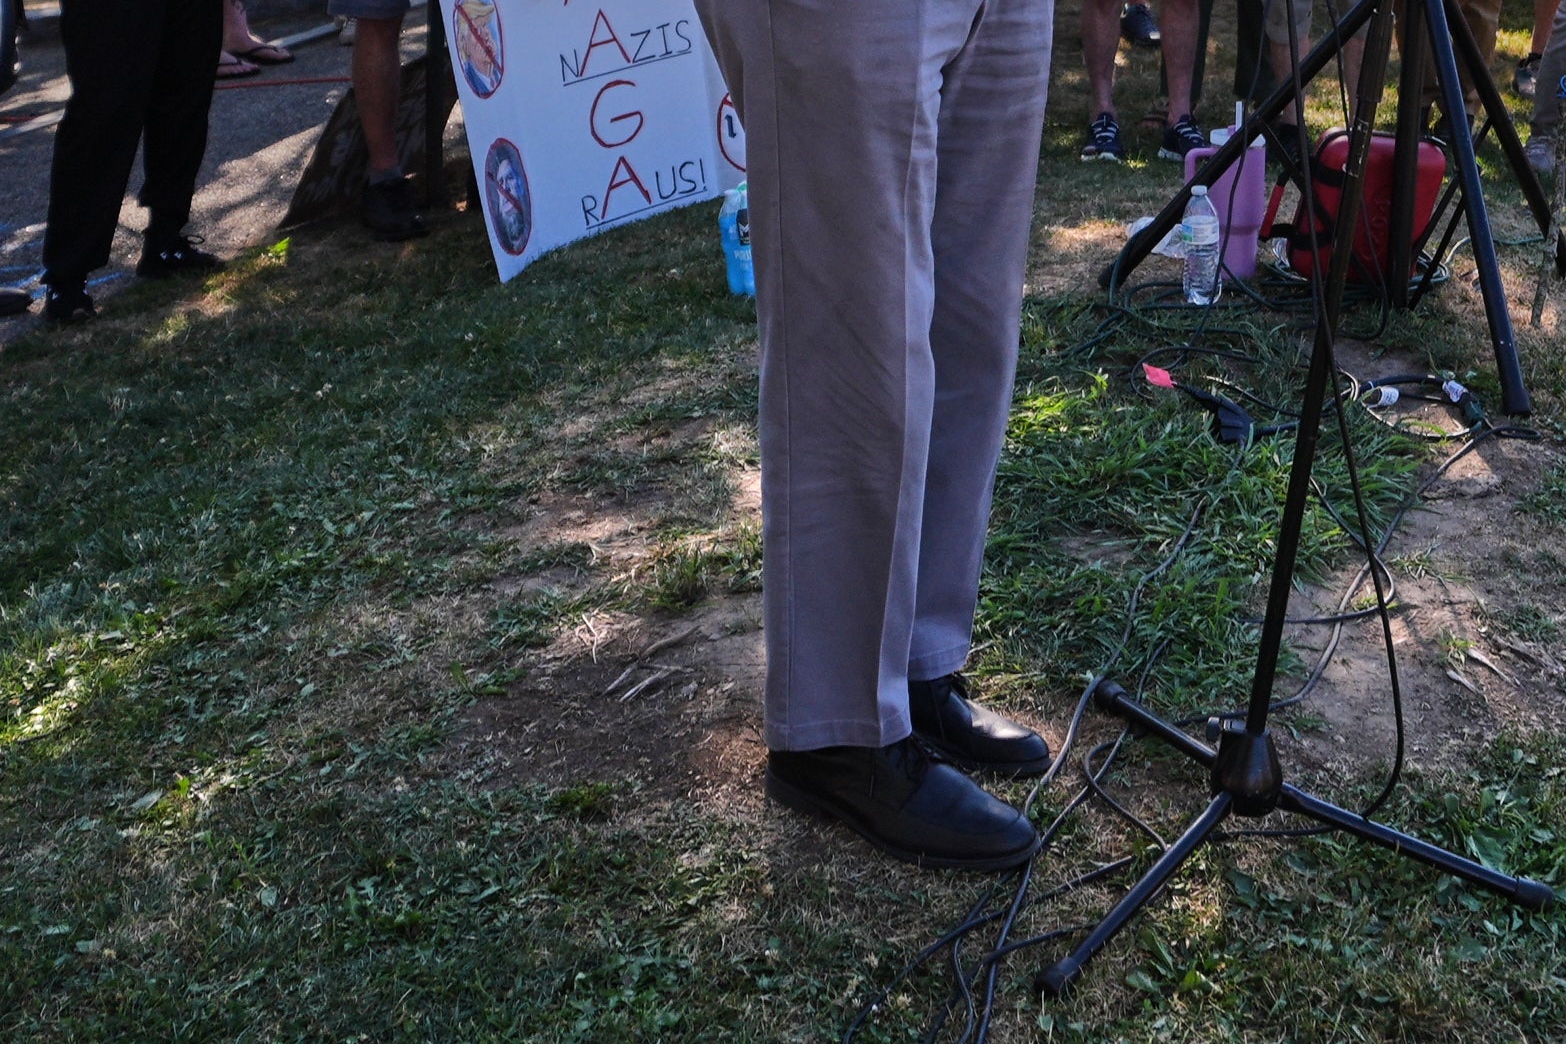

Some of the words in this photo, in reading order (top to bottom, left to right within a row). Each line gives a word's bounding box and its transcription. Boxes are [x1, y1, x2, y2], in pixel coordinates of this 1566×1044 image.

[560, 9, 692, 83] NAZIS
[590, 80, 644, 148] G
[582, 156, 707, 227] RAUS!
